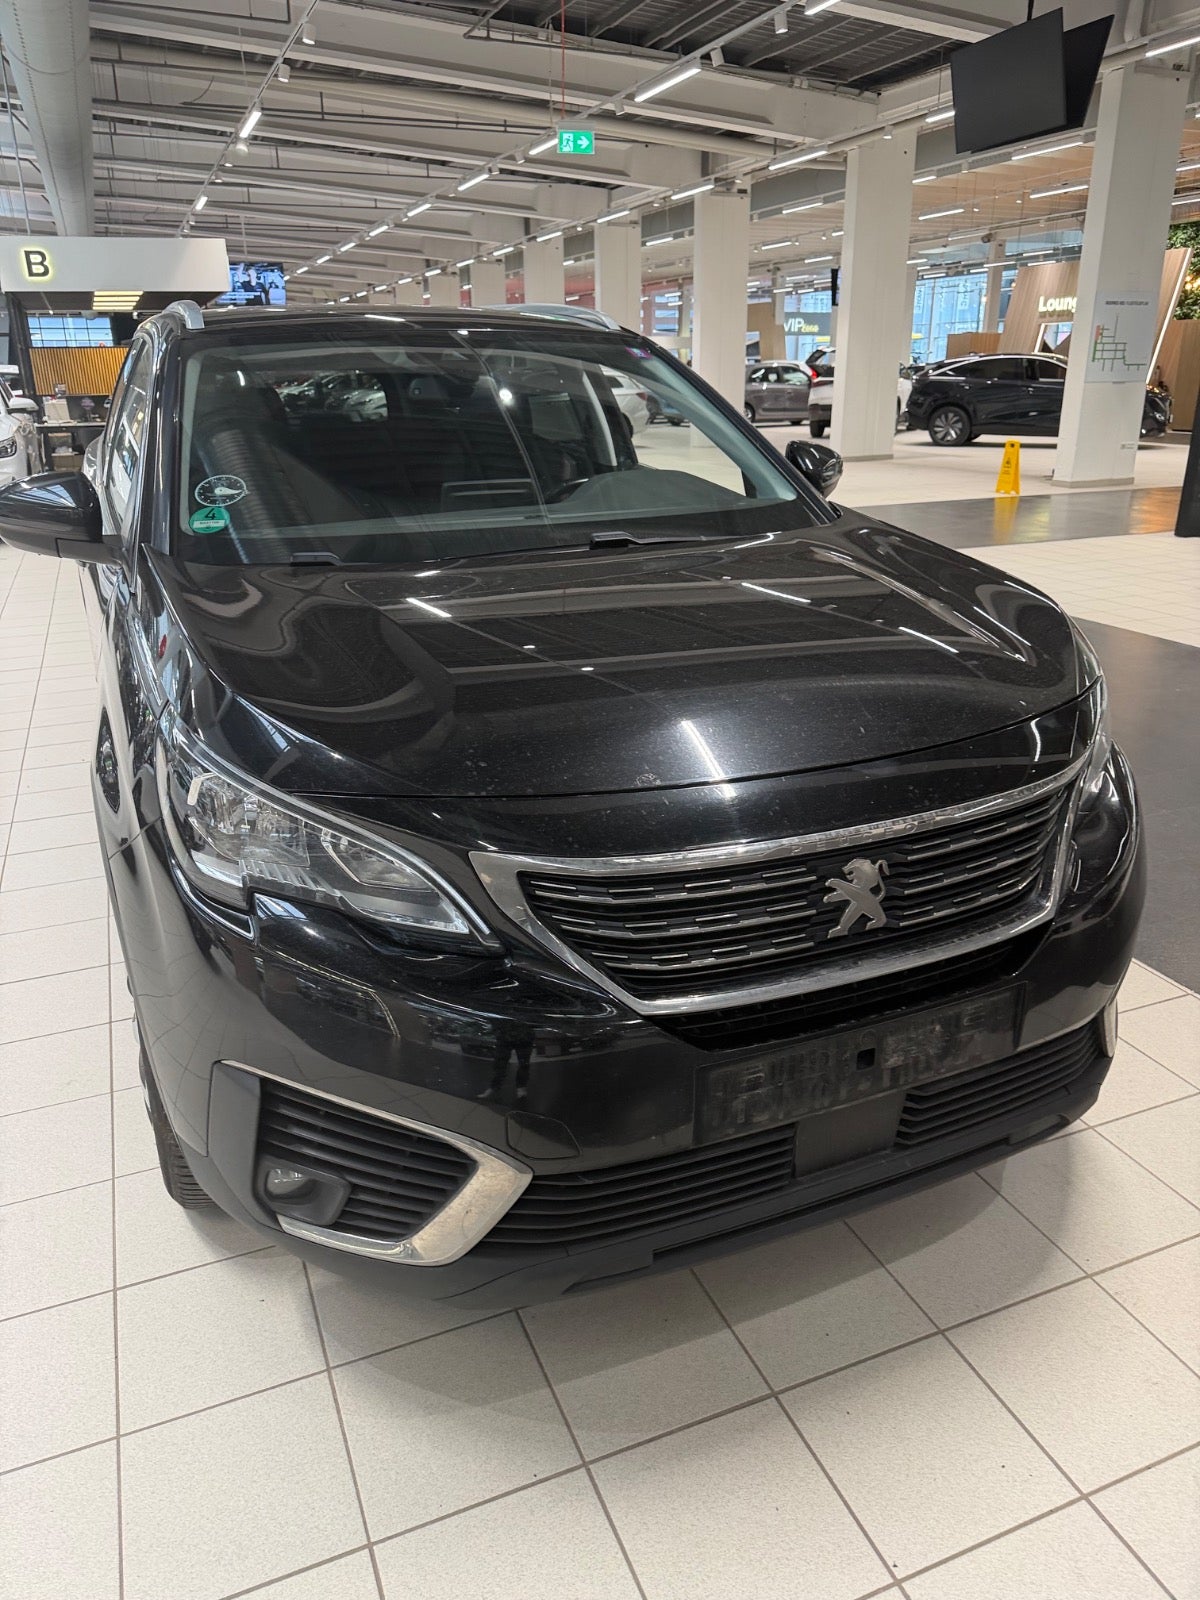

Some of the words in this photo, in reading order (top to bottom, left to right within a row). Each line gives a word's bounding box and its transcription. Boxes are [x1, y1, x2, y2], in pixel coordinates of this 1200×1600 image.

[24, 250, 50, 277] B
[1038, 296, 1077, 313] Loung
[784, 317, 805, 332] VIP
[204, 507, 217, 520] 4
